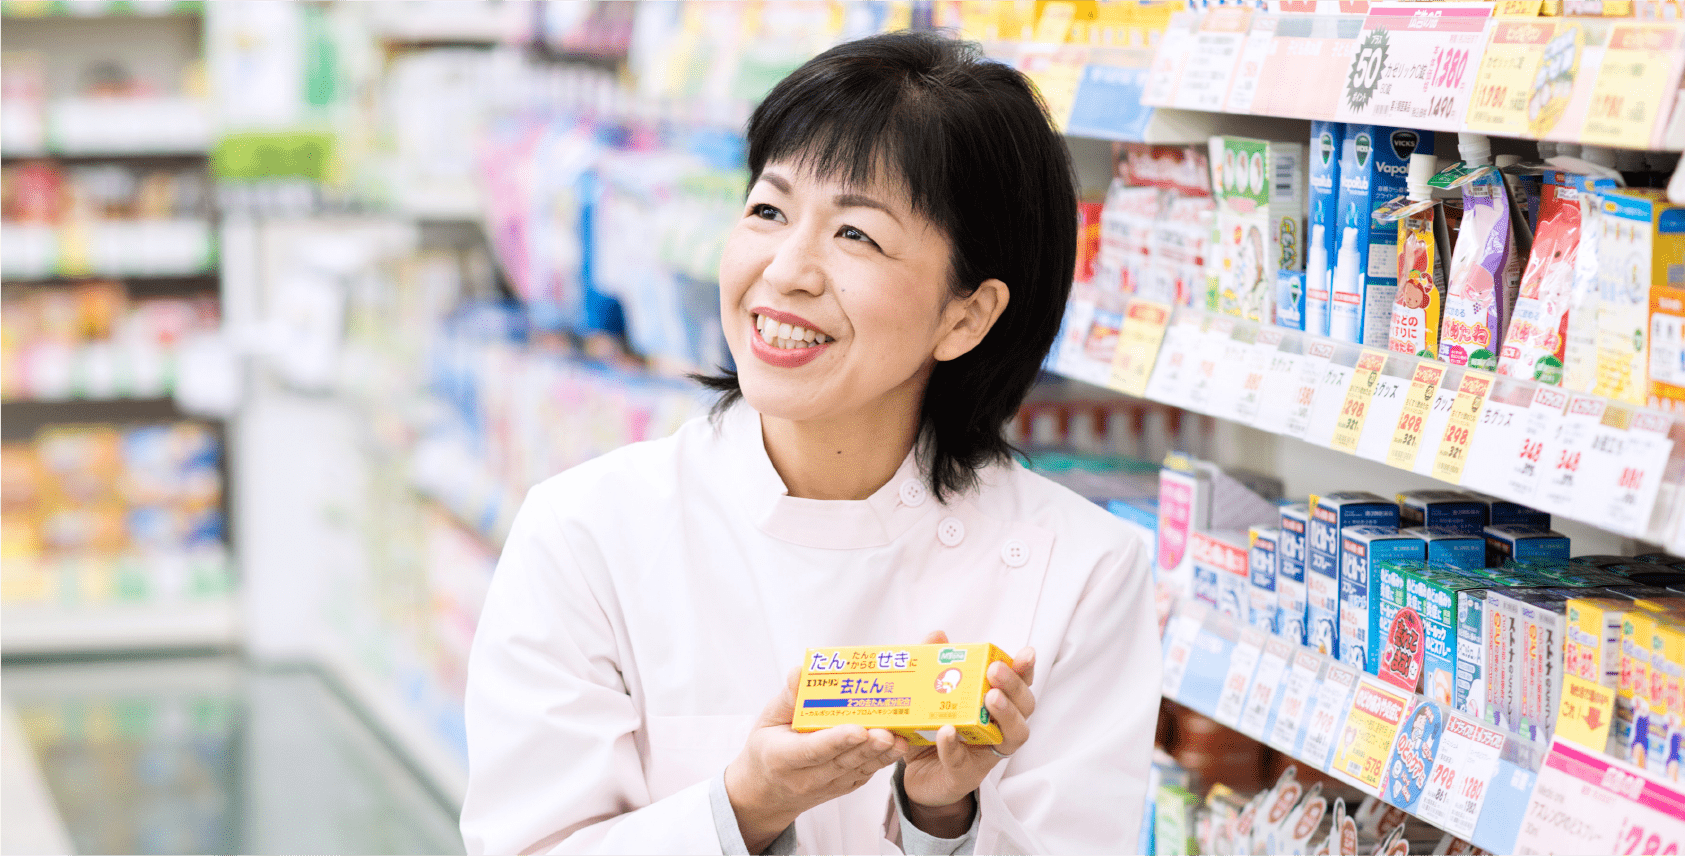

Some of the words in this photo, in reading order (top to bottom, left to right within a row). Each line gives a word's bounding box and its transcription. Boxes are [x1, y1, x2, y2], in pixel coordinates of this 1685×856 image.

[1354, 49, 1382, 88] 50
[1393, 139, 1416, 148] VICKS
[1376, 161, 1411, 176] Vapo
[1344, 399, 1365, 418] 298
[1400, 413, 1423, 433] 298
[1402, 433, 1417, 446] 321
[1446, 424, 1470, 445] 298
[850, 660, 876, 670] からむ
[852, 651, 876, 660] たんの
[1364, 756, 1382, 777] 578
[1433, 764, 1455, 790] 798
[1461, 775, 1484, 801] 1280
